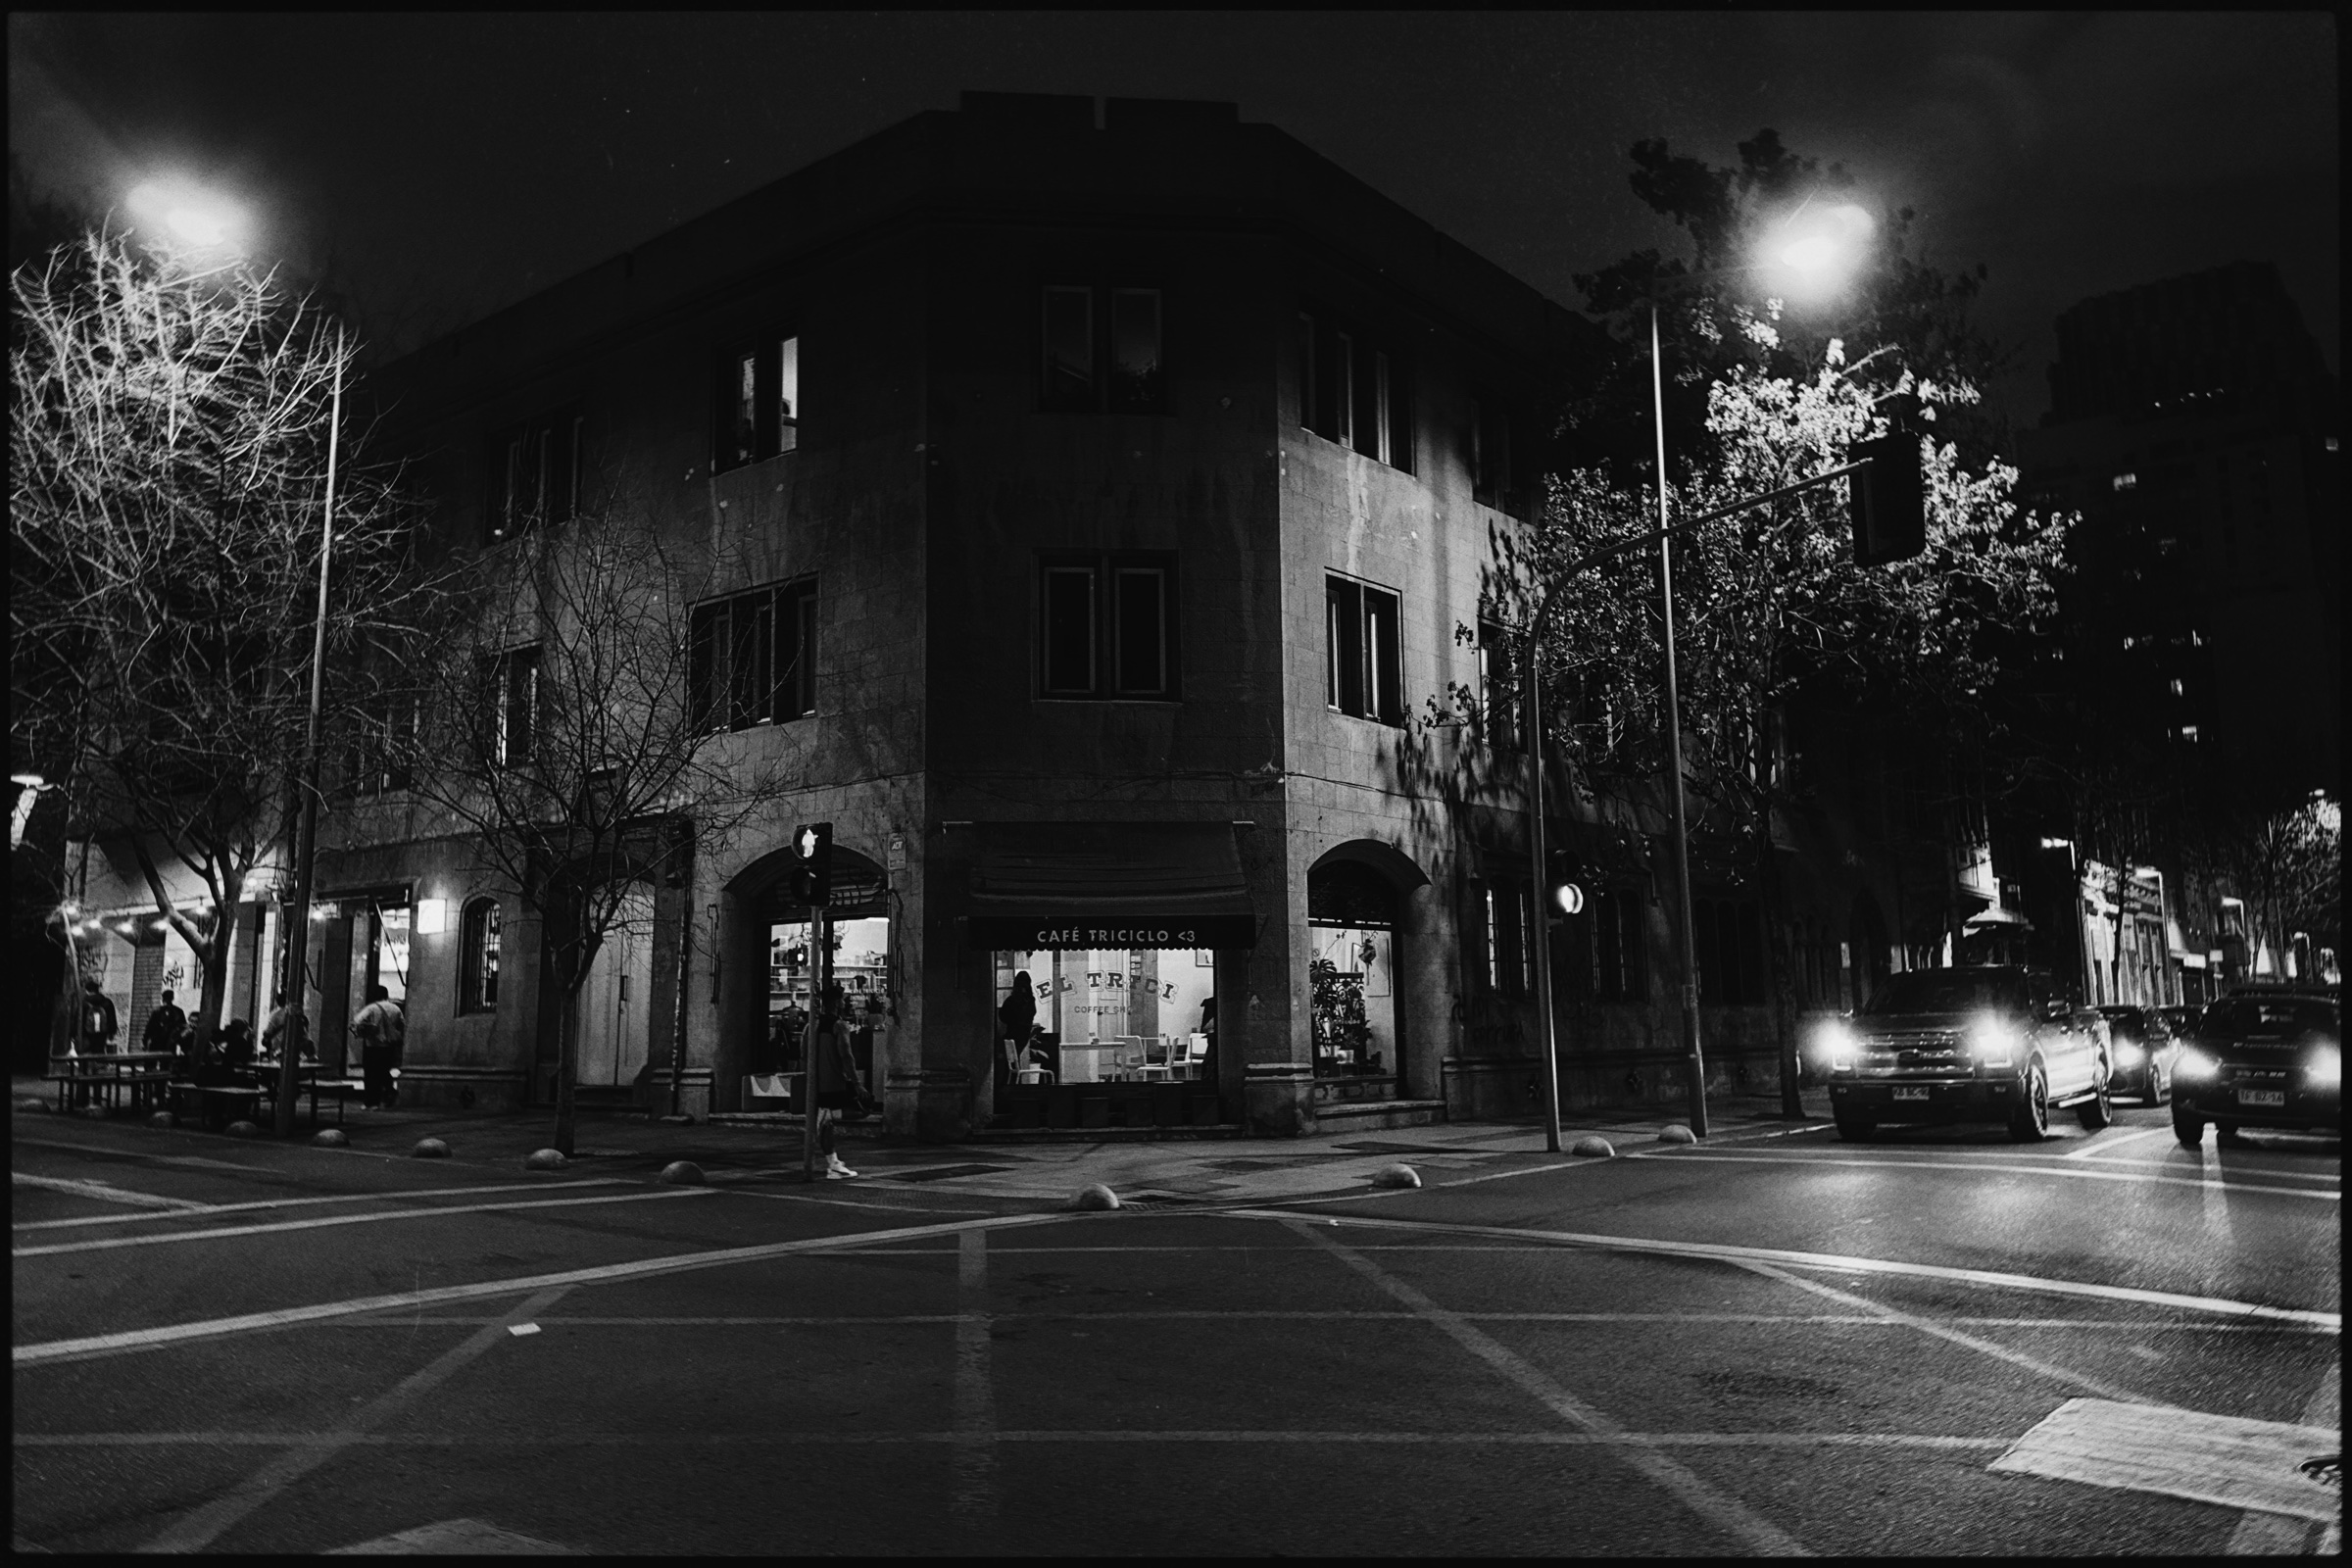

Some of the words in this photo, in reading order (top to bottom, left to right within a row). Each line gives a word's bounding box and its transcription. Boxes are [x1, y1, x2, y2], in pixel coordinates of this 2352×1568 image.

[1036, 926, 1080, 943] CAFÉ
[1089, 929, 1169, 943] TRICICLO
[1177, 930, 1196, 943] <3
[1035, 975, 1075, 1002] EL
[1113, 1005, 1138, 1014] SHO
